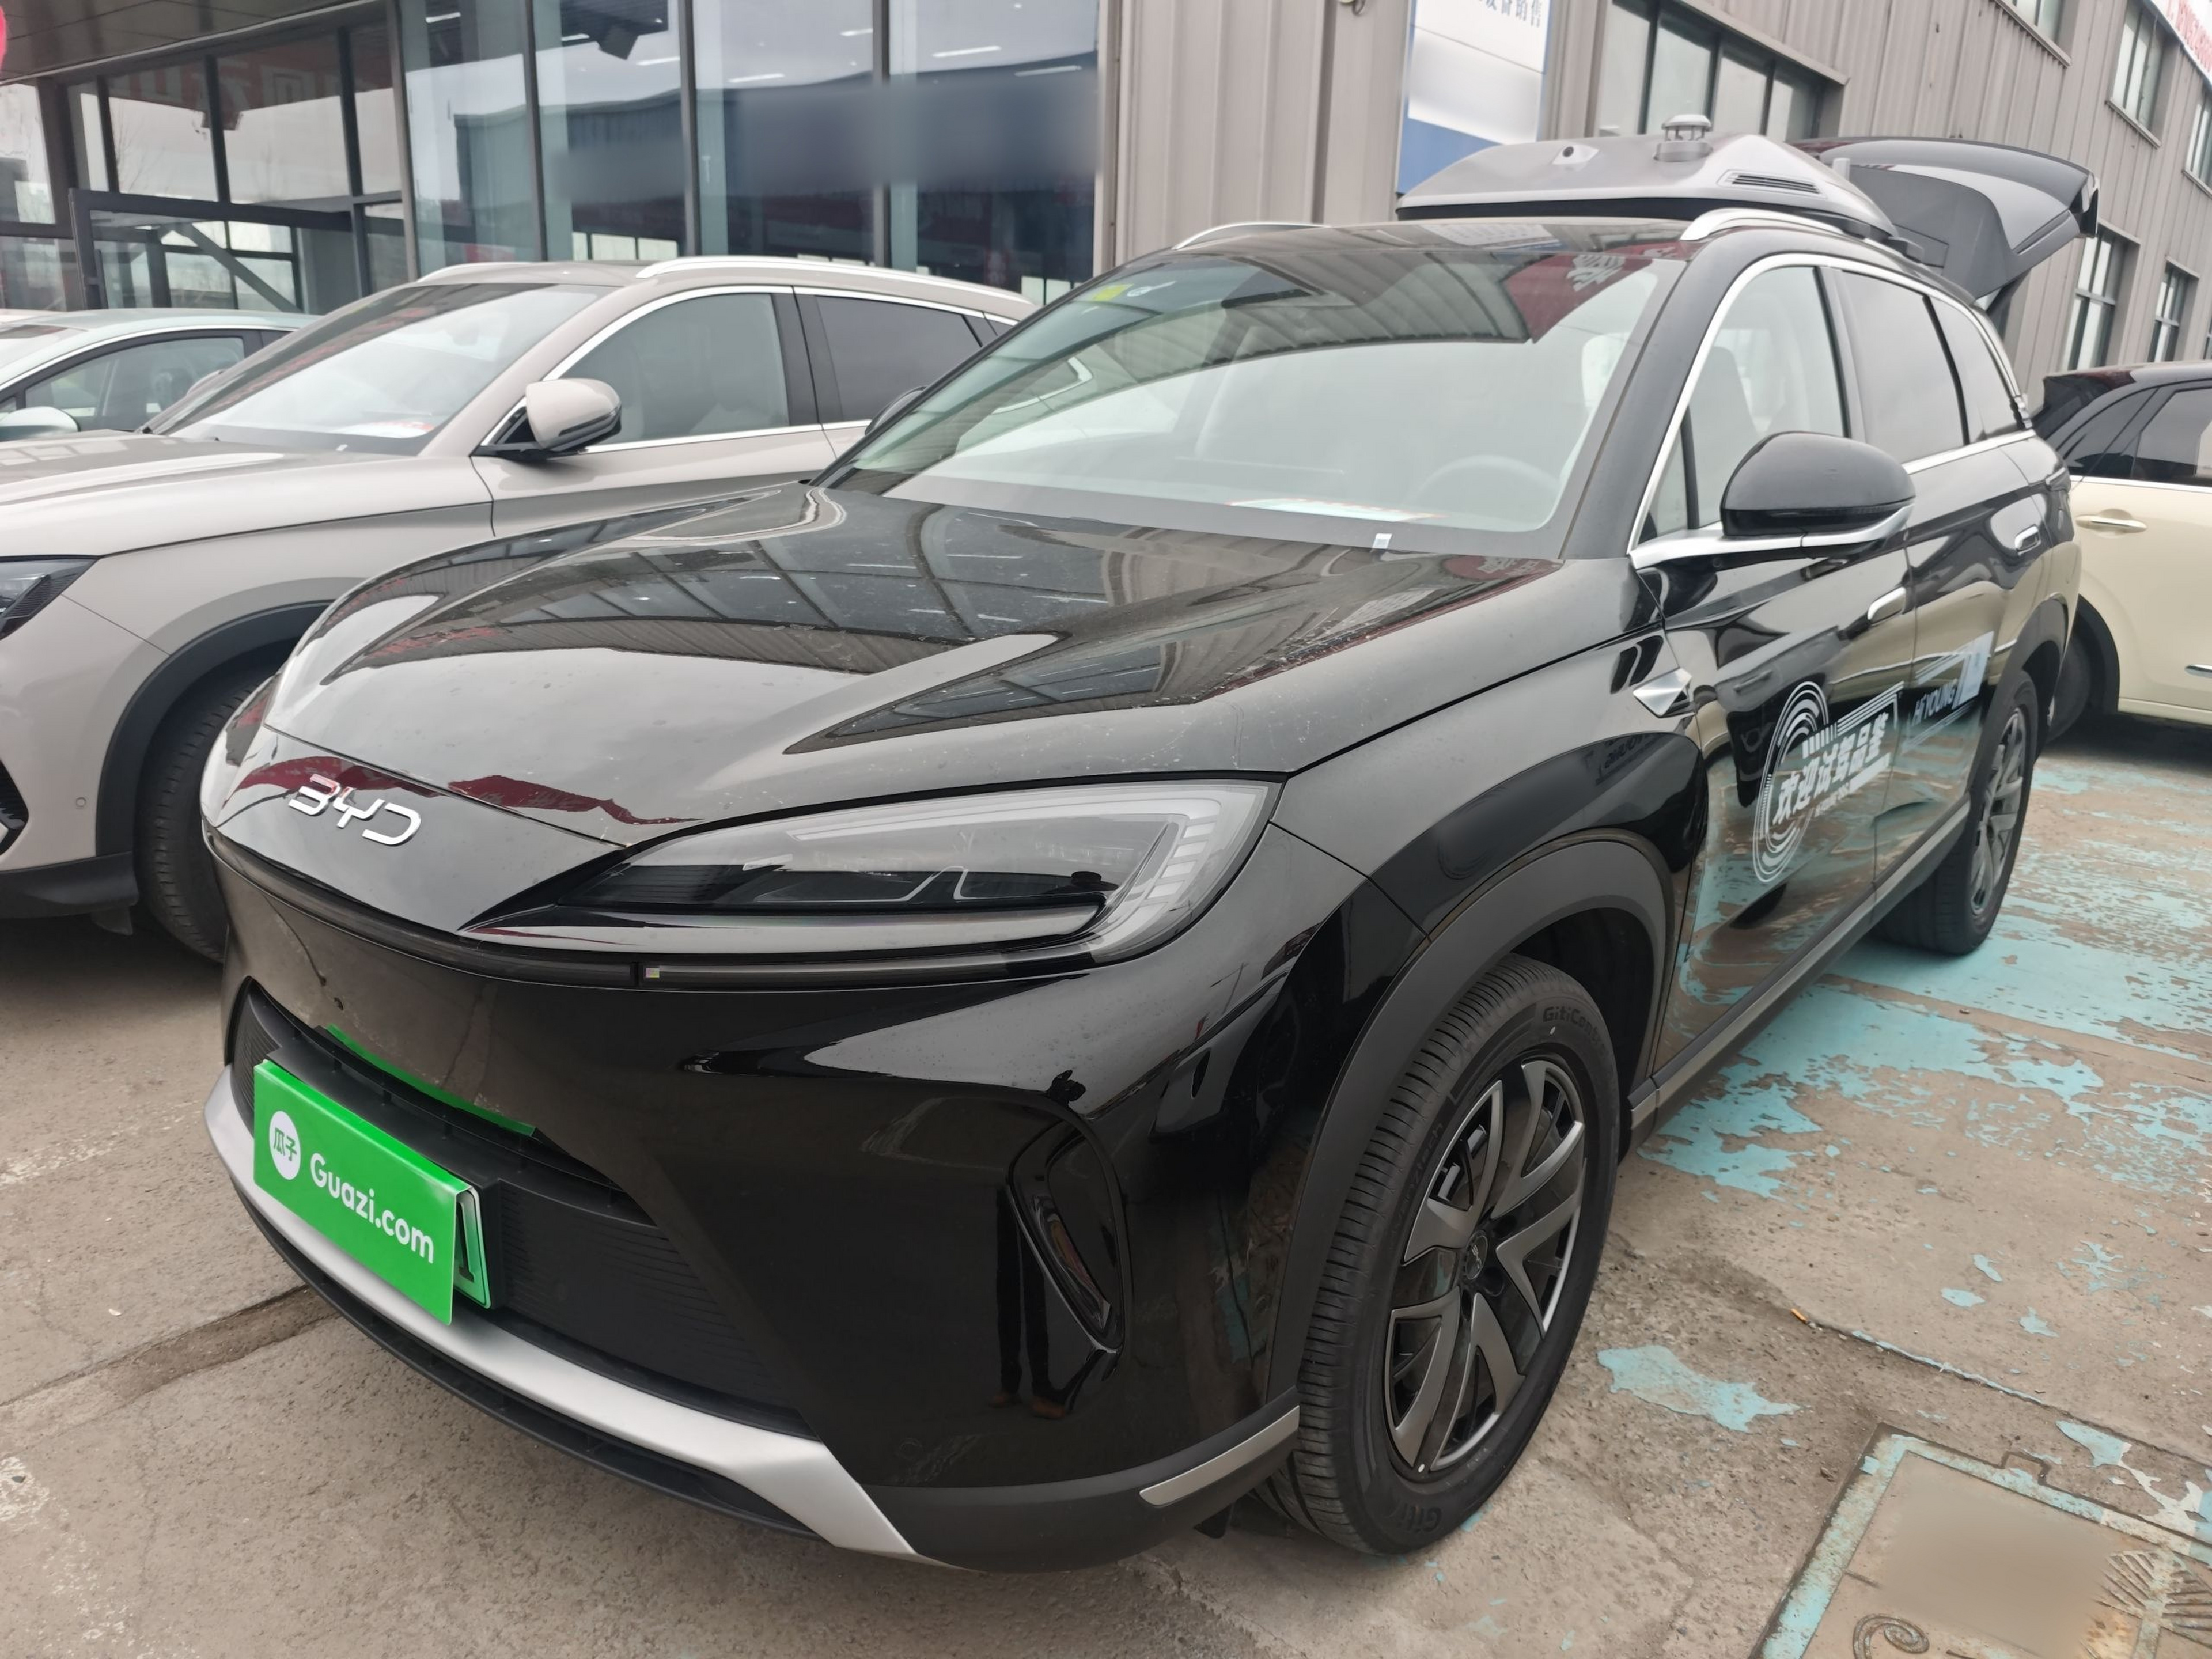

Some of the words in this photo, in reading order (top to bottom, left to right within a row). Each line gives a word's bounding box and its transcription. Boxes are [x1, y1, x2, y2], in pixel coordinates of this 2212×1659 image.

[288, 773, 421, 846] BYD
[1772, 712, 1889, 825] 欢迎试驾品鉴
[274, 1127, 298, 1162] 瓜子
[310, 1153, 434, 1264] Guazi.com
